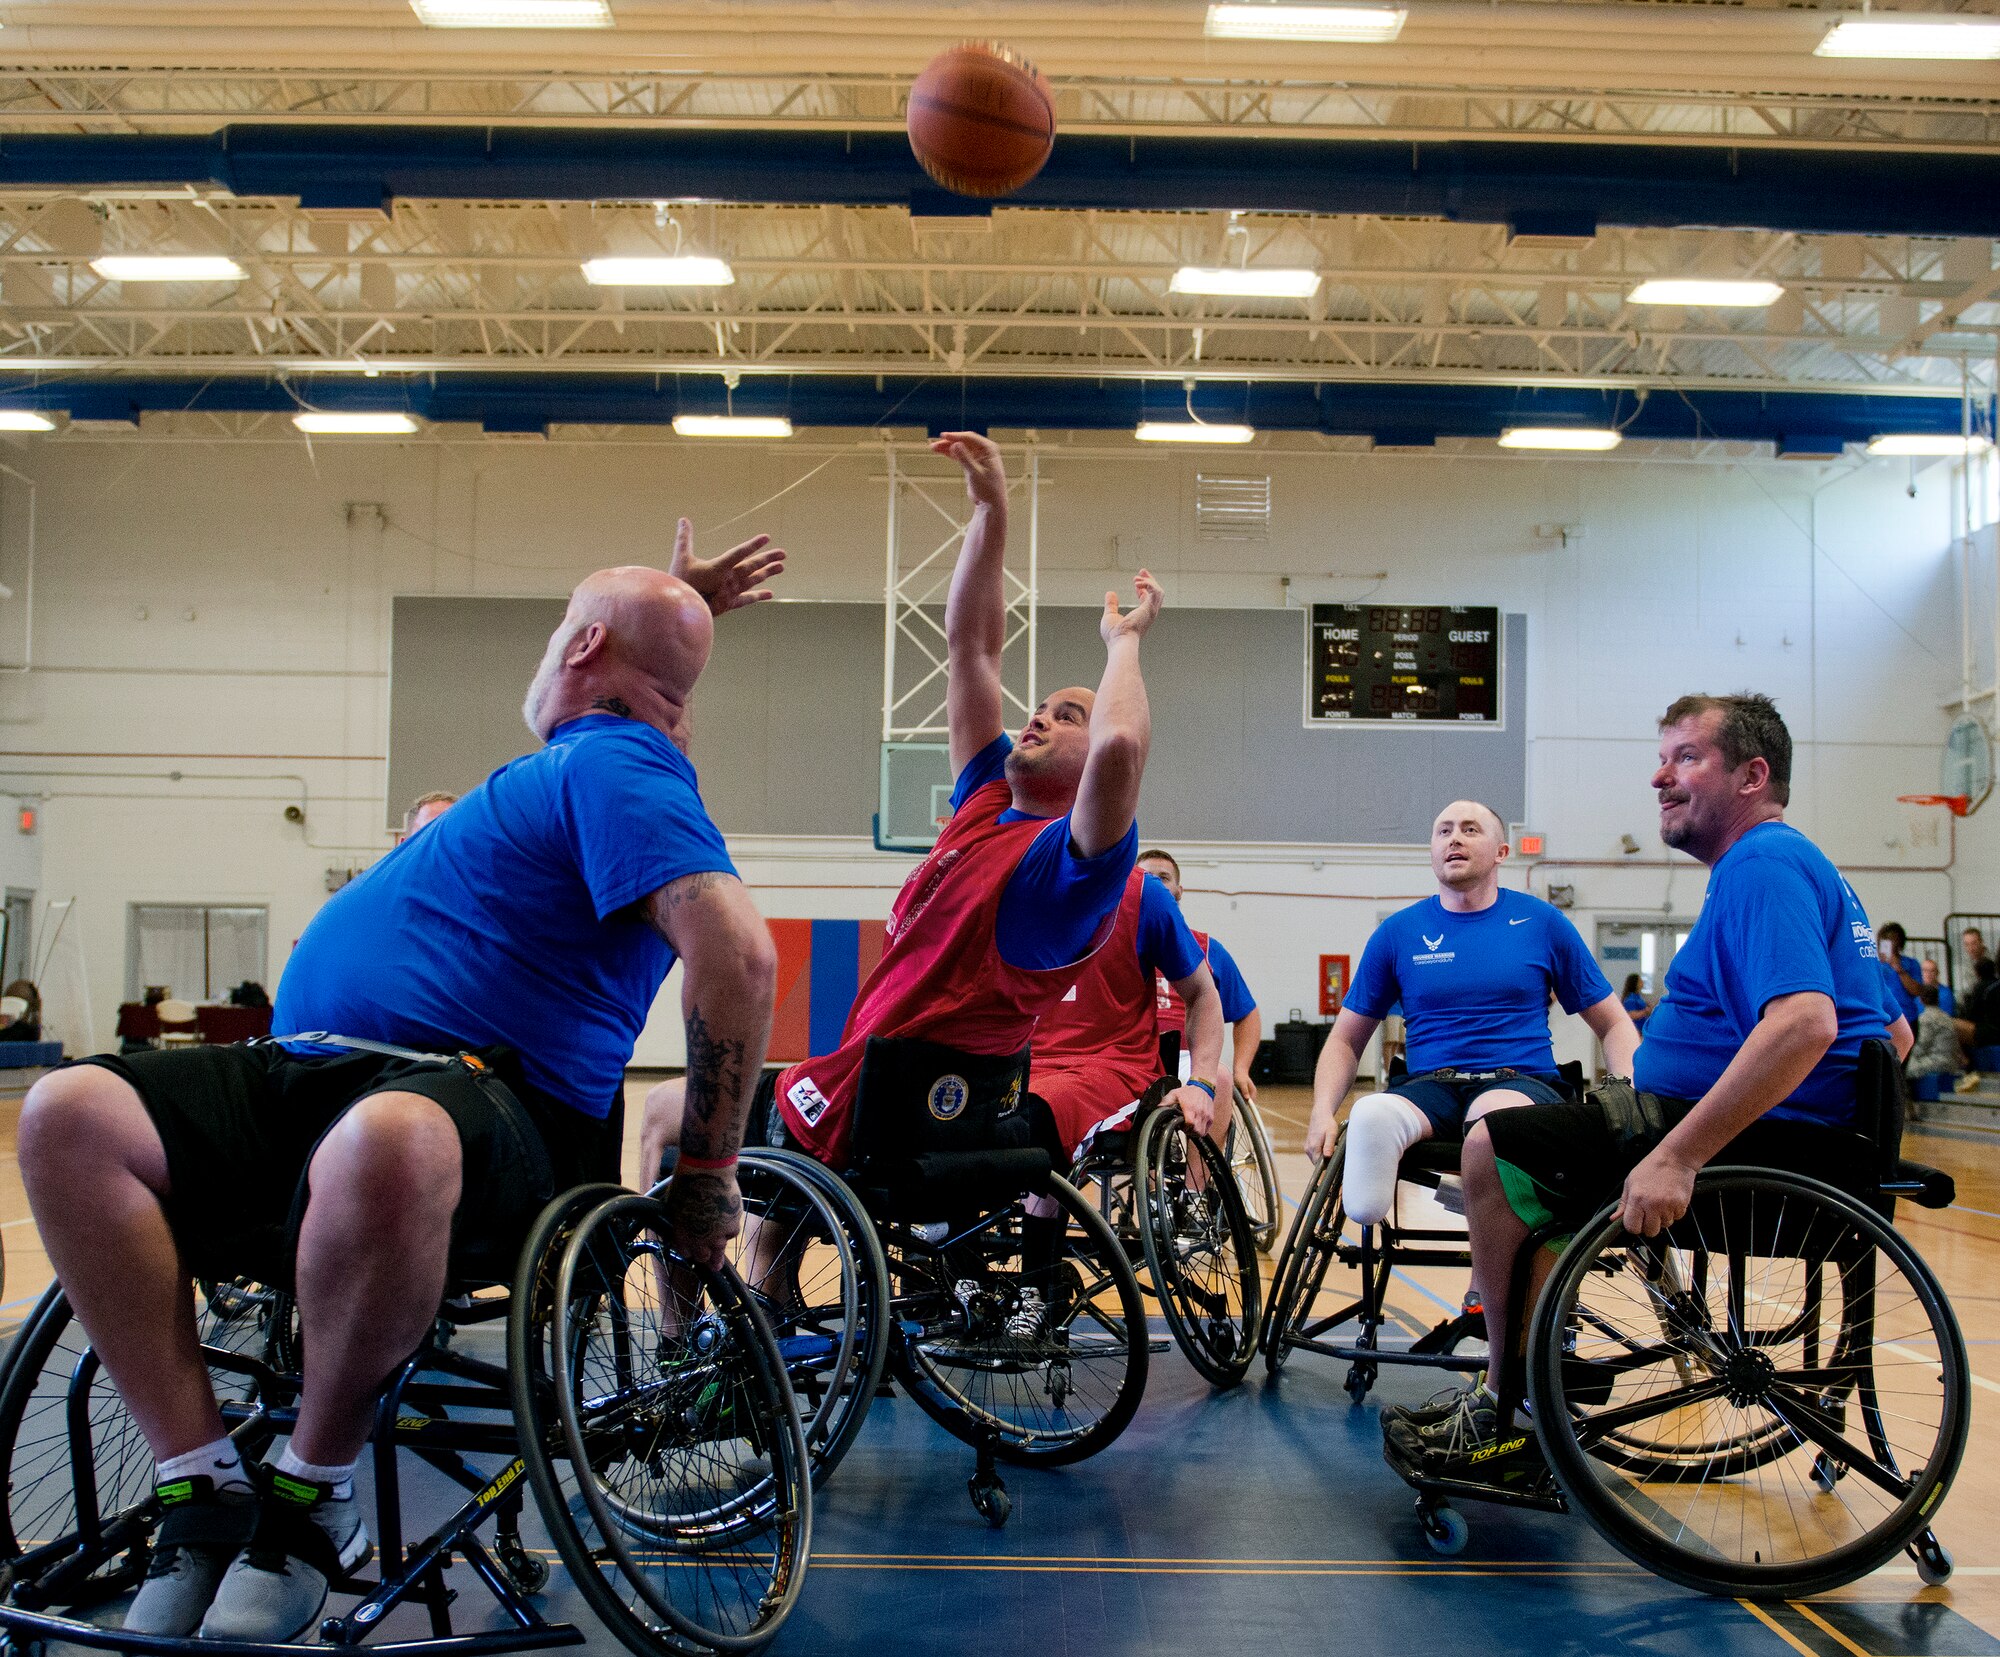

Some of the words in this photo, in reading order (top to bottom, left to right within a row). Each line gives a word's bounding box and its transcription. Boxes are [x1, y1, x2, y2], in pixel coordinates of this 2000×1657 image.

[1323, 628, 1360, 640] HOME
[1393, 633, 1419, 641] PERIOD
[1448, 630, 1490, 643] GUEST
[1392, 661, 1417, 670] BONUS
[1325, 674, 1350, 683] FOULS
[1391, 676, 1418, 684] PLAYER
[1459, 676, 1484, 685] FOULS
[1458, 712, 1484, 720] POINTS
[1471, 1446, 1497, 1462] TOP
[1498, 1437, 1526, 1453] END
[476, 1485, 497, 1507] Top
[495, 1467, 515, 1490] End
